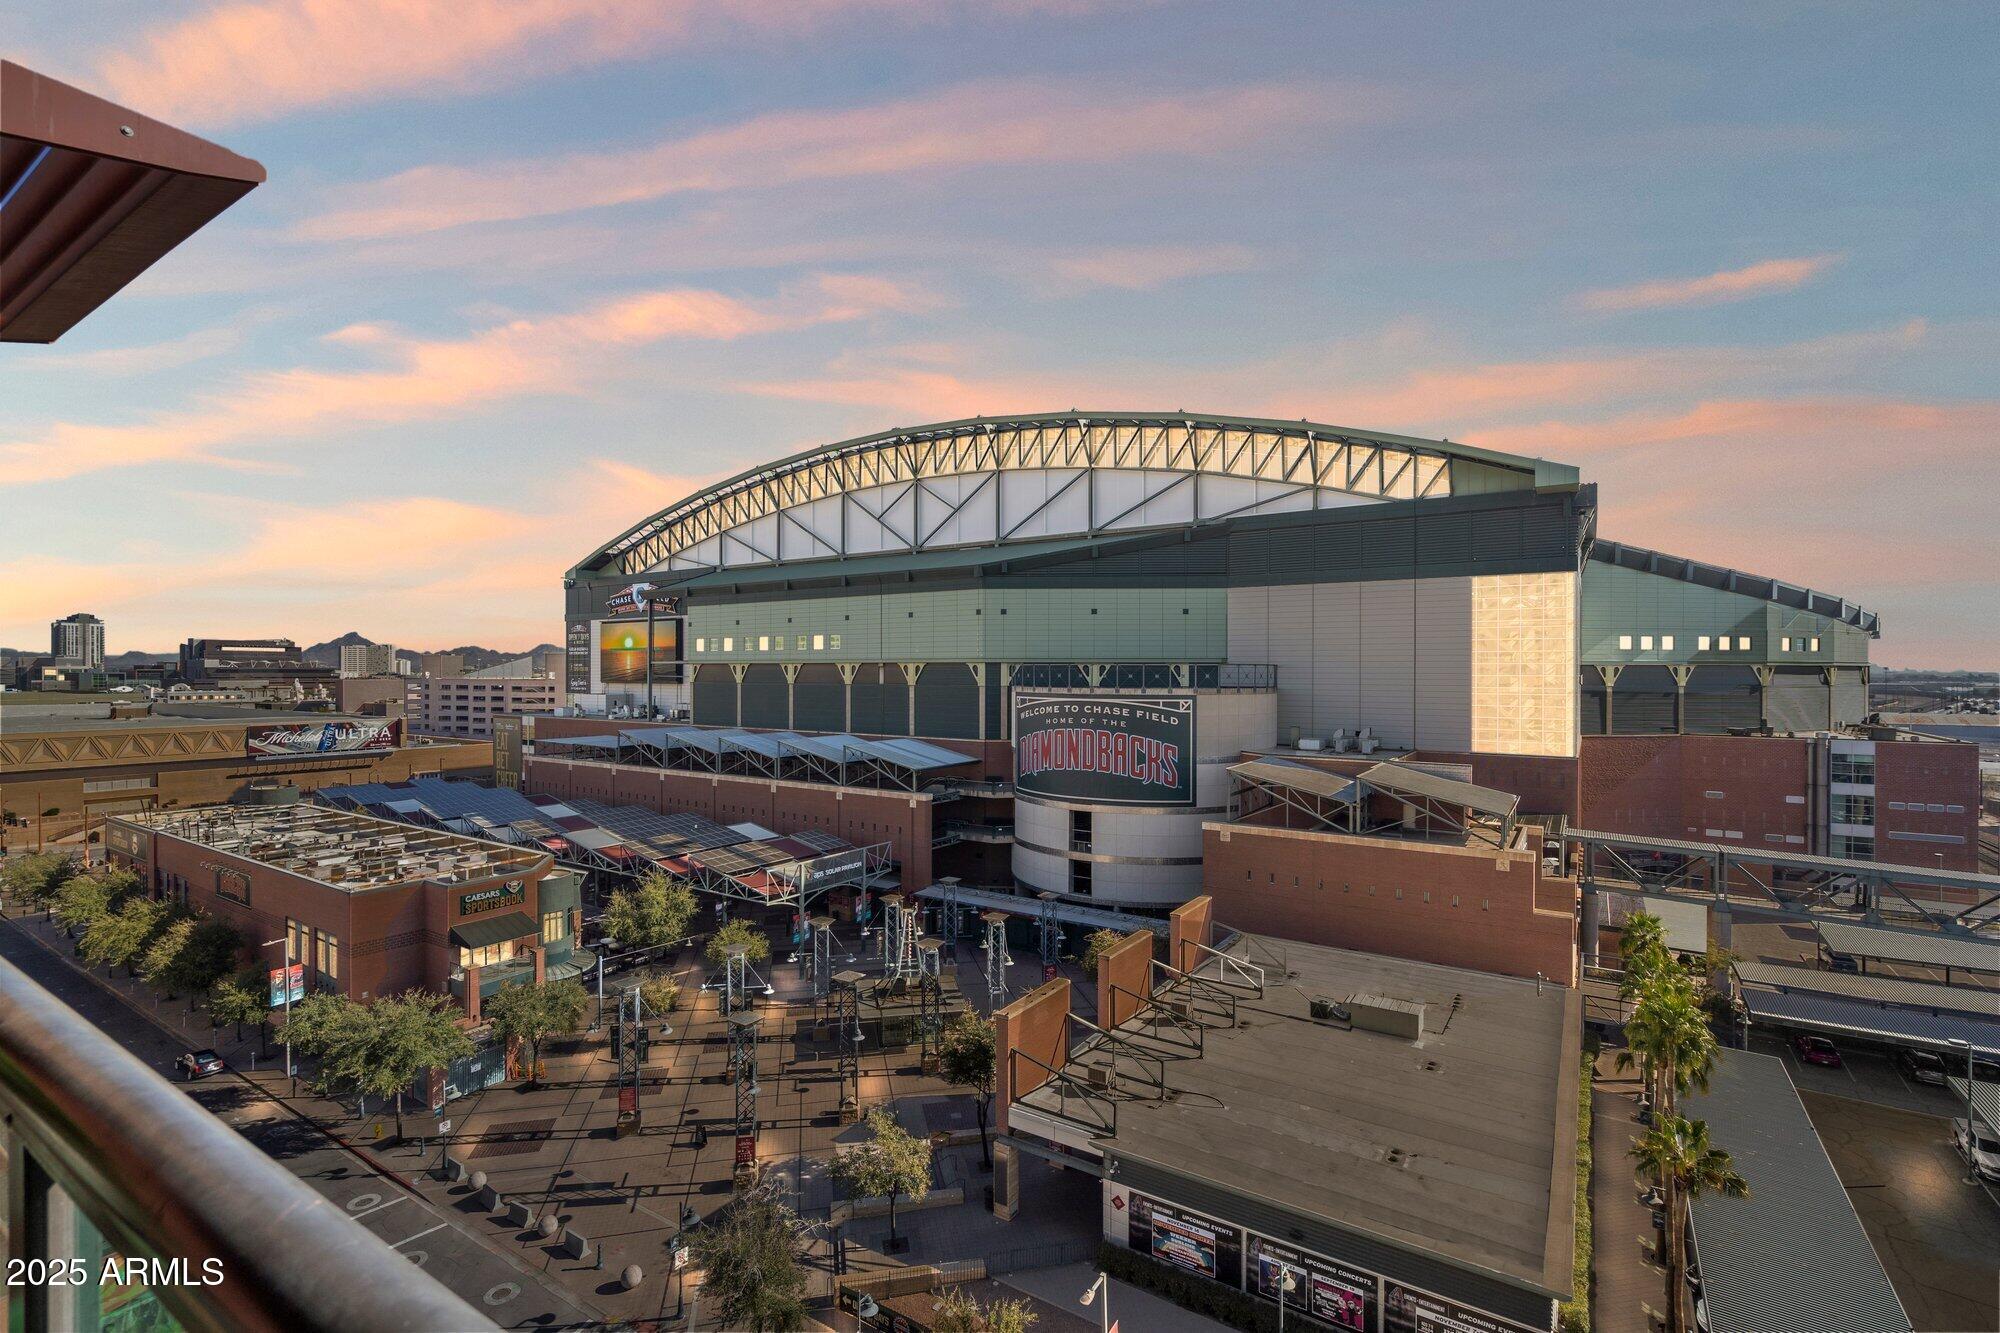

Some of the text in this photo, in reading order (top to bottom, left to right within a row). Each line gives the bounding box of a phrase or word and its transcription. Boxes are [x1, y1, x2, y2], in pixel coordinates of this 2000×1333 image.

[612, 595, 631, 606] CHASE
[1020, 705, 1179, 725] WELCOME TO CHASE FIELD
[1081, 717, 1095, 725] OF
[1102, 718, 1127, 728] THE
[255, 727, 392, 746] Michelob ULTRA
[496, 731, 509, 750] EAT
[496, 751, 509, 770] BET
[1019, 728, 1179, 789] DIAMONDBACKS
[825, 866, 841, 876] SOLAR
[841, 861, 862, 871] PAVILION
[465, 889, 501, 903] CAESARS
[465, 894, 523, 915] SPORTSBOOK
[1181, 1214, 1210, 1229] UPCOMING
[1211, 1225, 1234, 1237] EVENTS
[1304, 1257, 1337, 1274] UPCOMING
[1337, 1269, 1372, 1286] CONCERTS
[1434, 1315, 1471, 1332] NOVEMBER
[1457, 1312, 1497, 1330] UPCOMING
